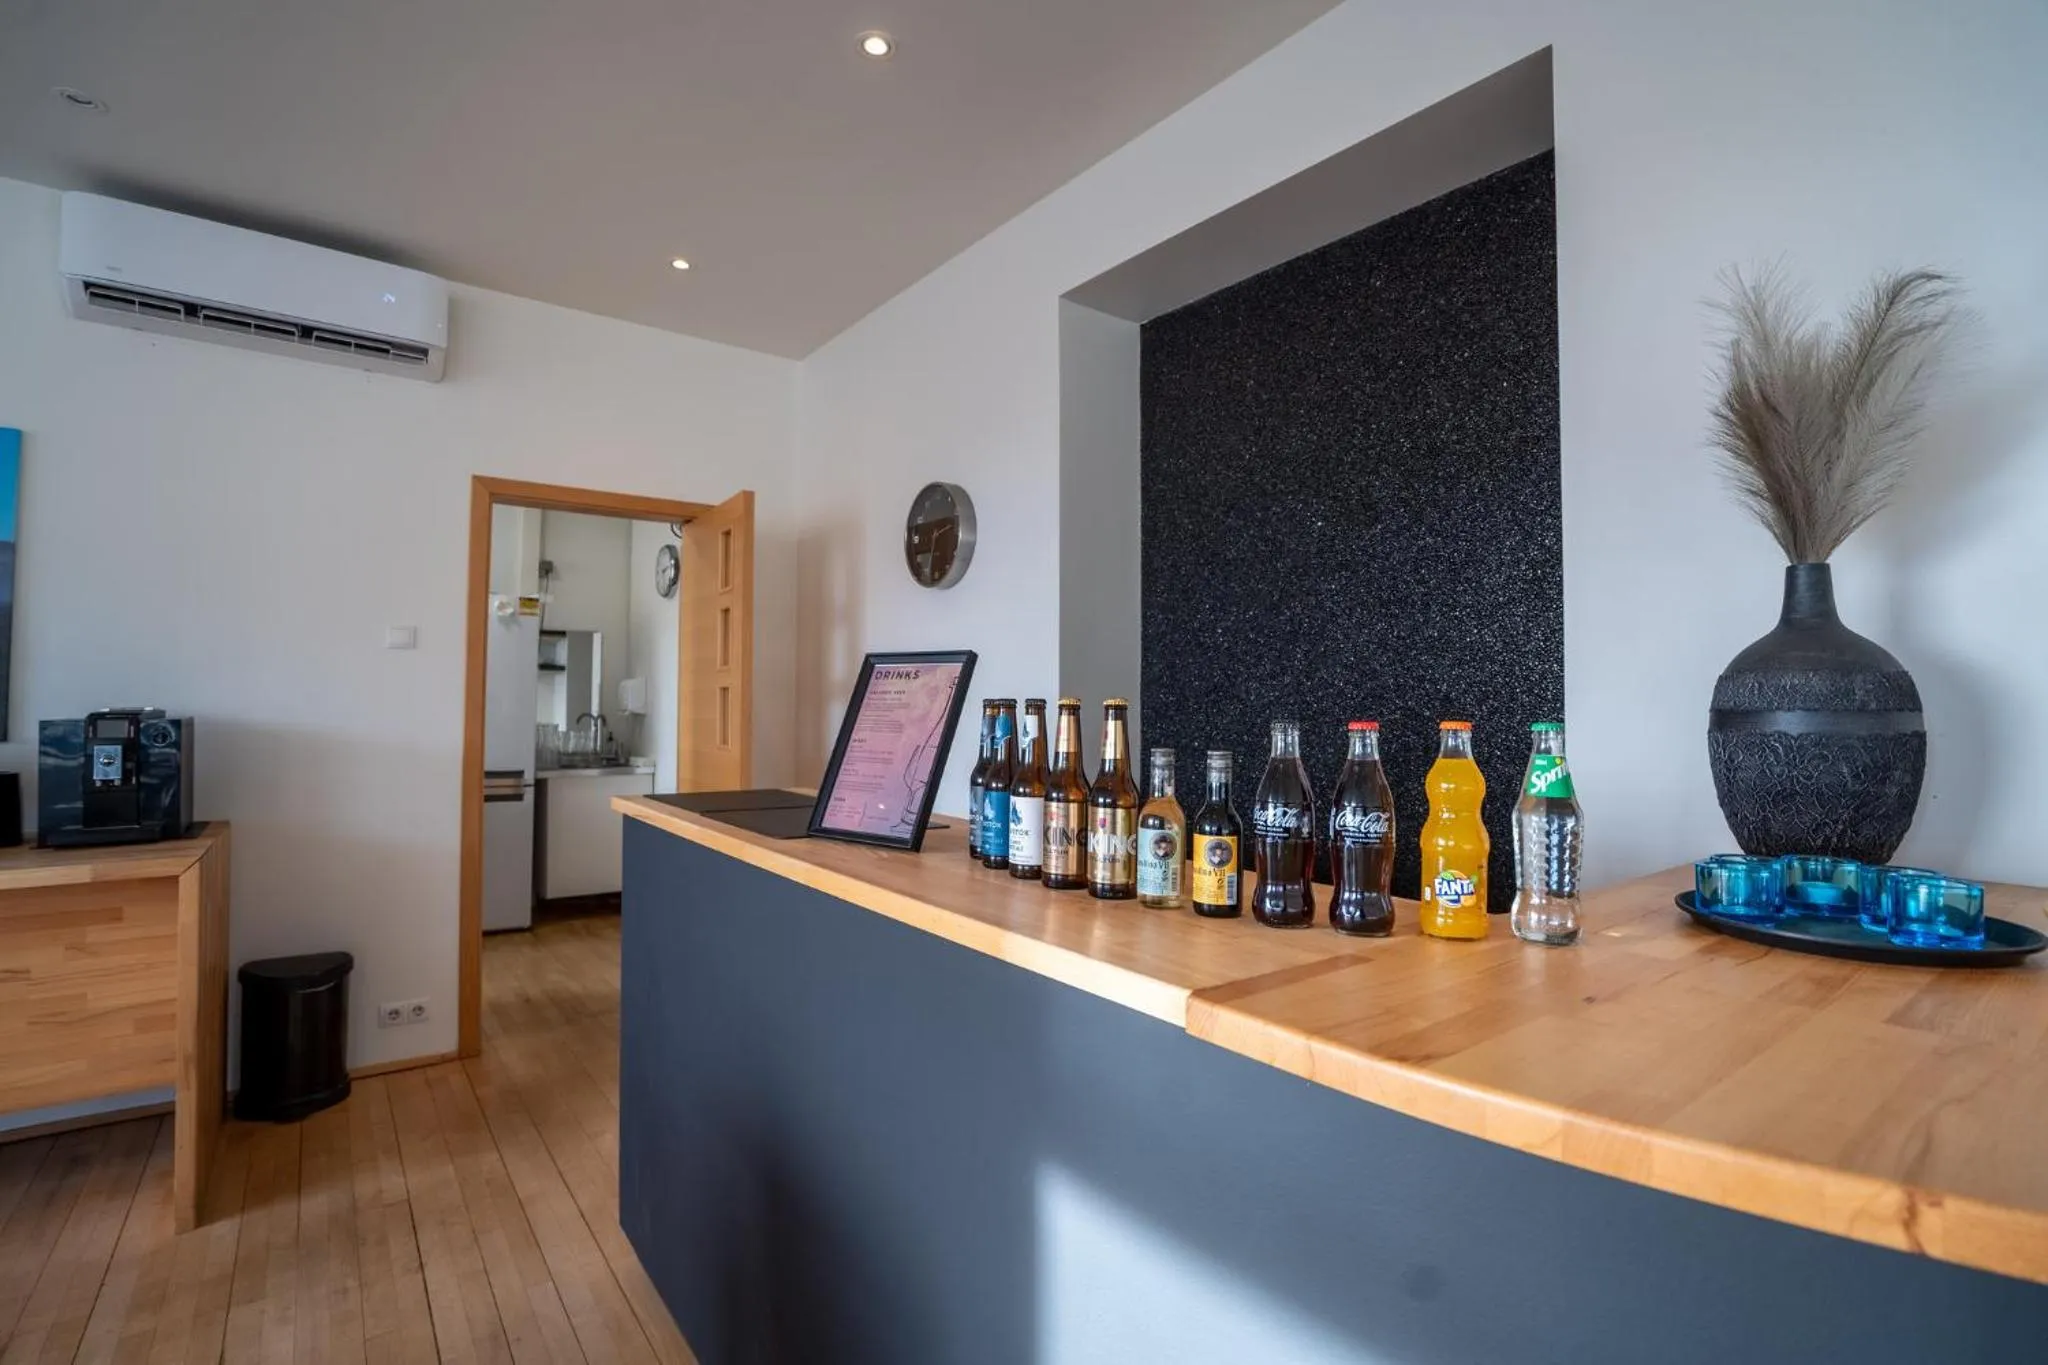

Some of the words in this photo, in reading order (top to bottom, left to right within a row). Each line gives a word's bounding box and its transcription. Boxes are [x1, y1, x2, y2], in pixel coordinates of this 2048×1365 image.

[875, 669, 921, 680] DRINKS
[1530, 764, 1567, 794] Sprit
[1335, 809, 1391, 833] Coca-Cola
[1088, 832, 1136, 856] KING
[1434, 877, 1476, 896] FANTA
